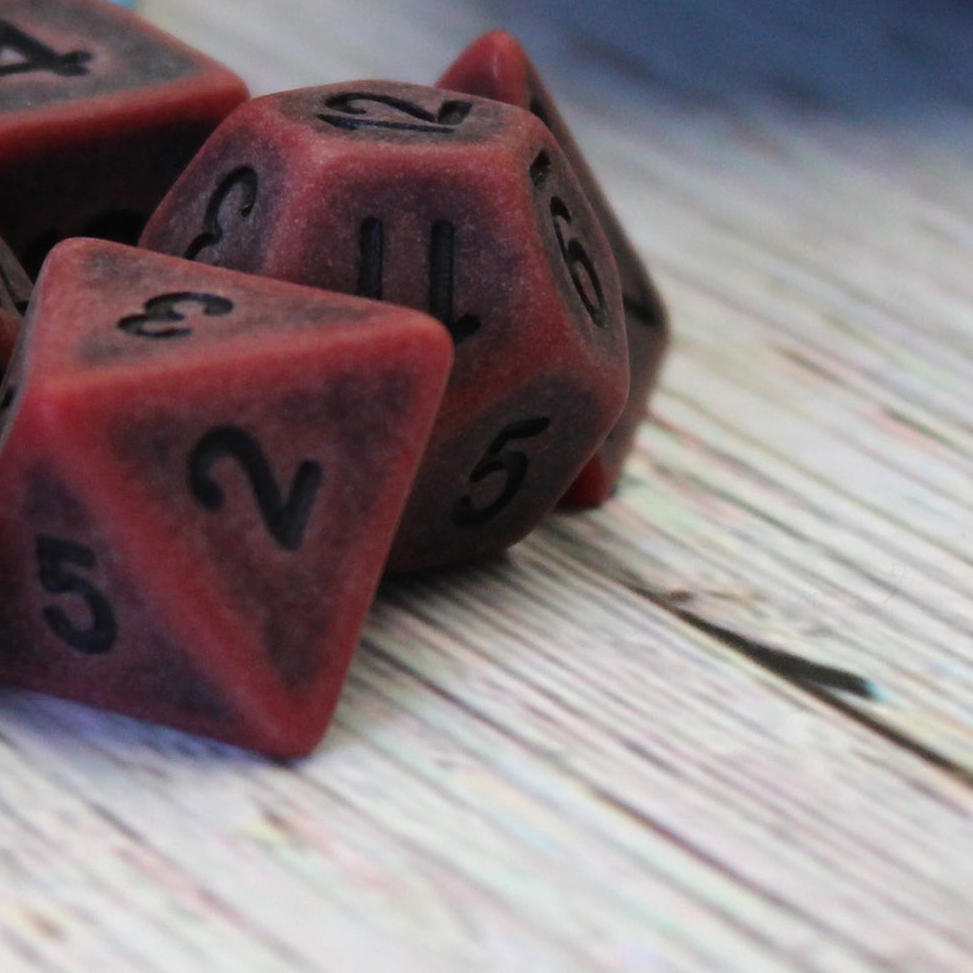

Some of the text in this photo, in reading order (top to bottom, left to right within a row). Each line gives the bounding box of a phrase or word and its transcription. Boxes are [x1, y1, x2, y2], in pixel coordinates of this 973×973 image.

[118, 291, 235, 339] 3
[188, 429, 323, 553] 2
[451, 417, 550, 527] 5
[36, 535, 119, 655] 5
